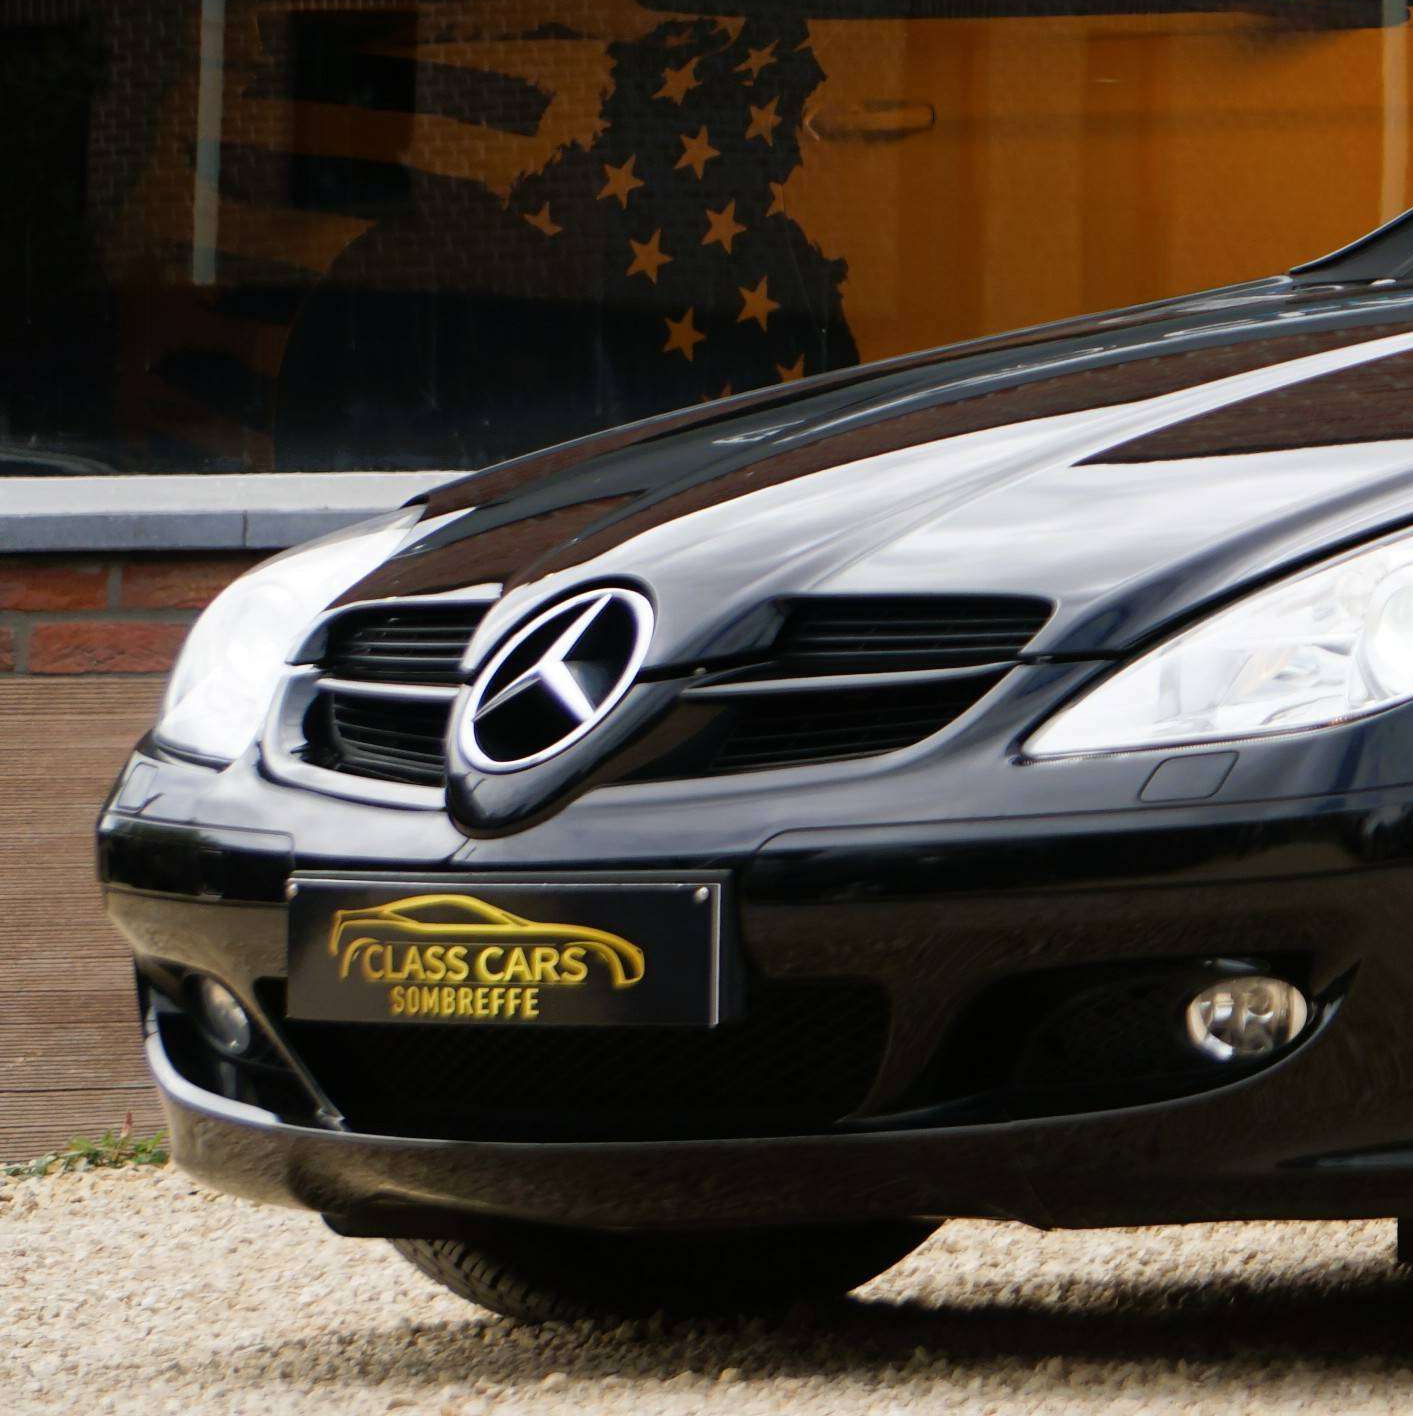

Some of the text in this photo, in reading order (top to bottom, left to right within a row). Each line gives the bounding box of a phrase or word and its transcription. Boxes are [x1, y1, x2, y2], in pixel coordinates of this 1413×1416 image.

[361, 944, 590, 982] CLASS CARS
[390, 985, 540, 1017] SOMBREFFE
